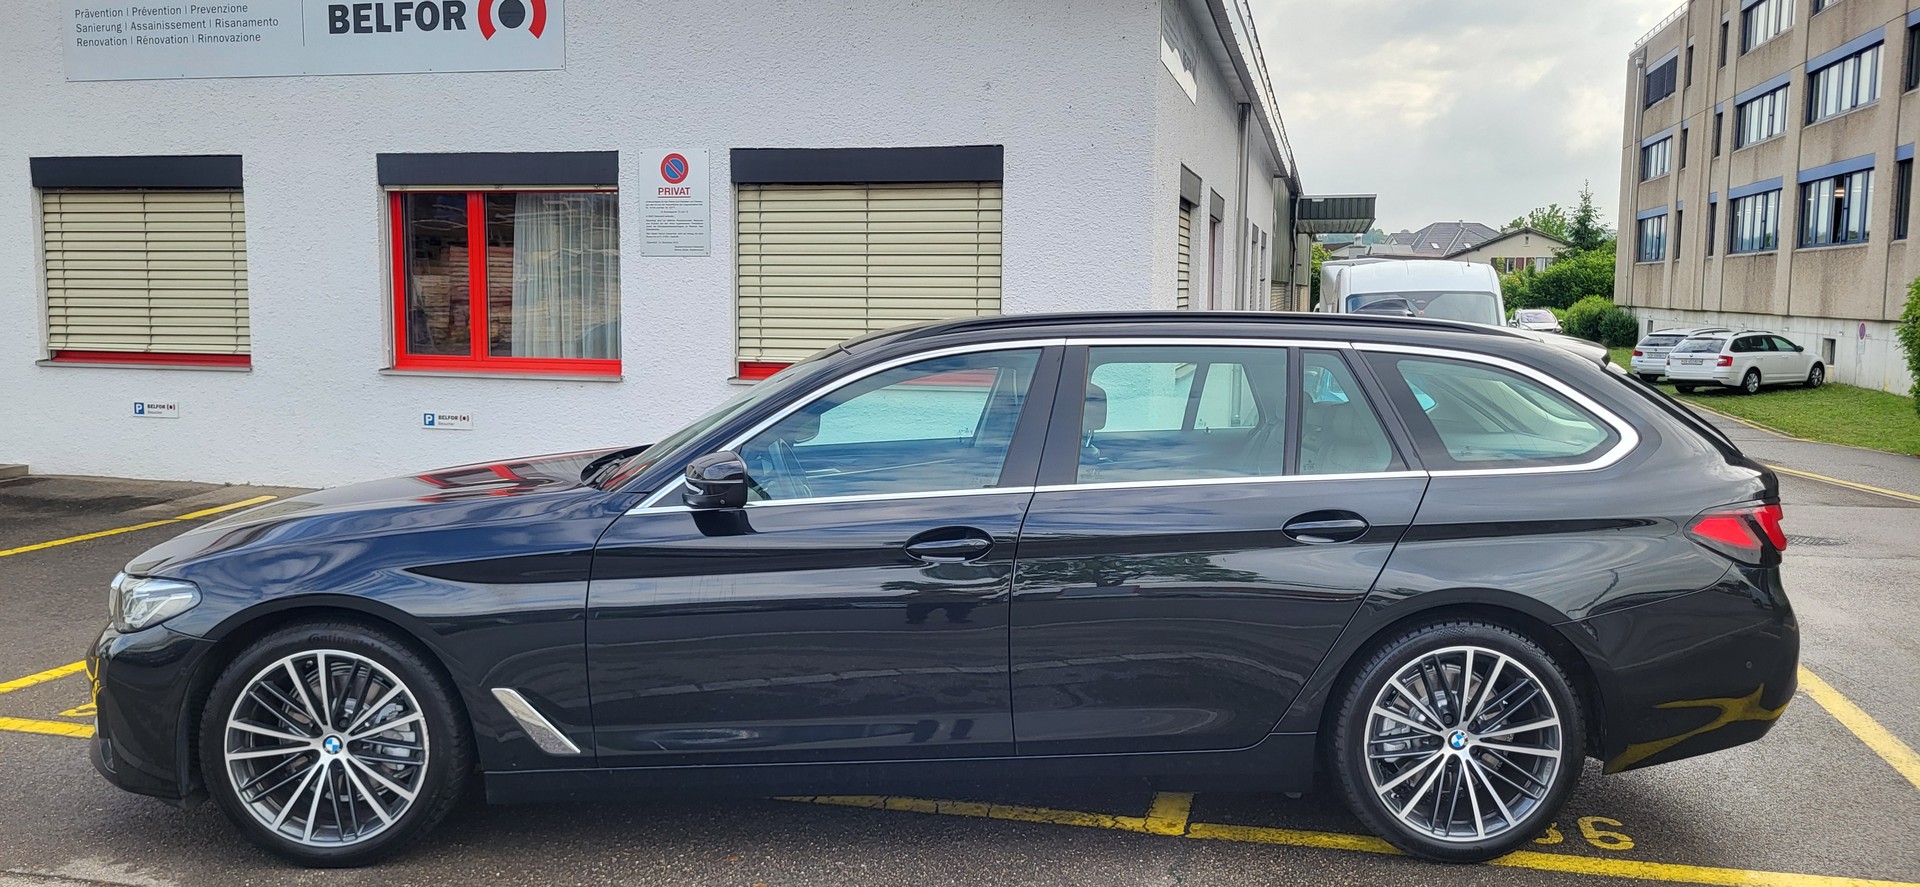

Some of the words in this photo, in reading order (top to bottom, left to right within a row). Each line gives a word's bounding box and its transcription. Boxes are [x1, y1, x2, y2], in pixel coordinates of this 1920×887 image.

[75, 8, 123, 19] Prävention
[132, 5, 182, 17] Prévention
[190, 3, 248, 14] Prevenzione
[328, 0, 467, 35] BELFOR
[76, 22, 122, 34] Sanierung
[130, 19, 206, 31] Assainissement
[215, 17, 279, 28] Risanamento
[76, 36, 128, 47] Renovation
[136, 34, 189, 45] Rénovation
[197, 32, 261, 43] Rinnovazione
[657, 187, 691, 195] PRIVAT
